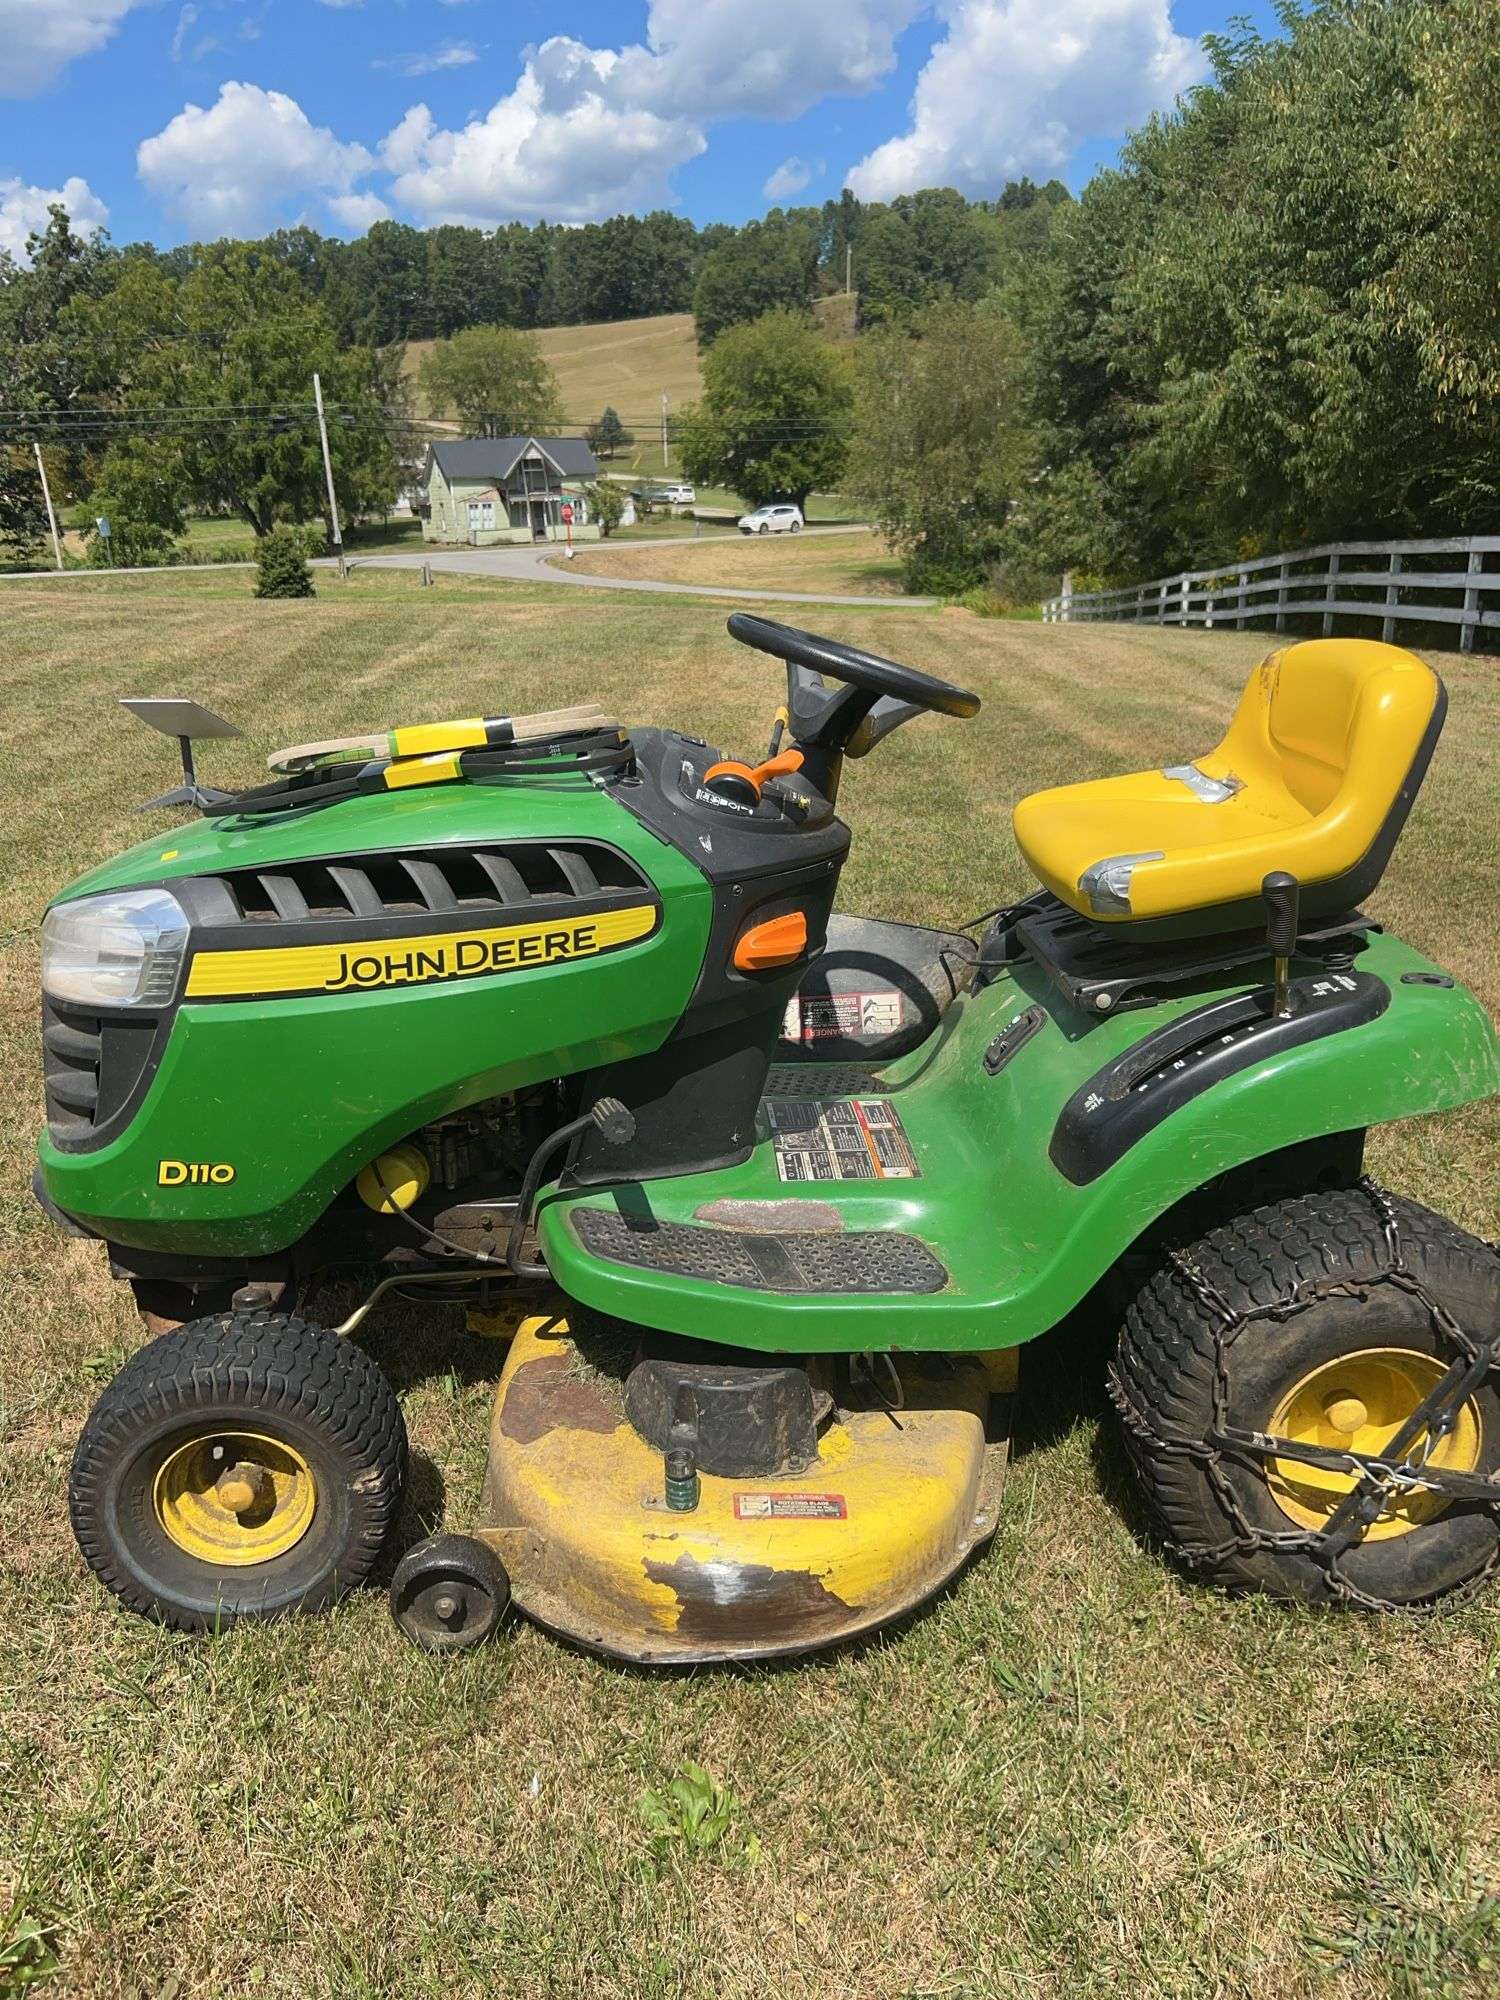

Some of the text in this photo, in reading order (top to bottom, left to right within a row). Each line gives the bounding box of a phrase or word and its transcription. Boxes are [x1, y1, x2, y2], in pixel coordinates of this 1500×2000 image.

[325, 925, 597, 986] JOHN DEERE
[1221, 1034, 1235, 1044] 3
[1173, 1059, 1186, 1070] 2
[1138, 1084, 1148, 1092] 1
[158, 1160, 236, 1186] D110
